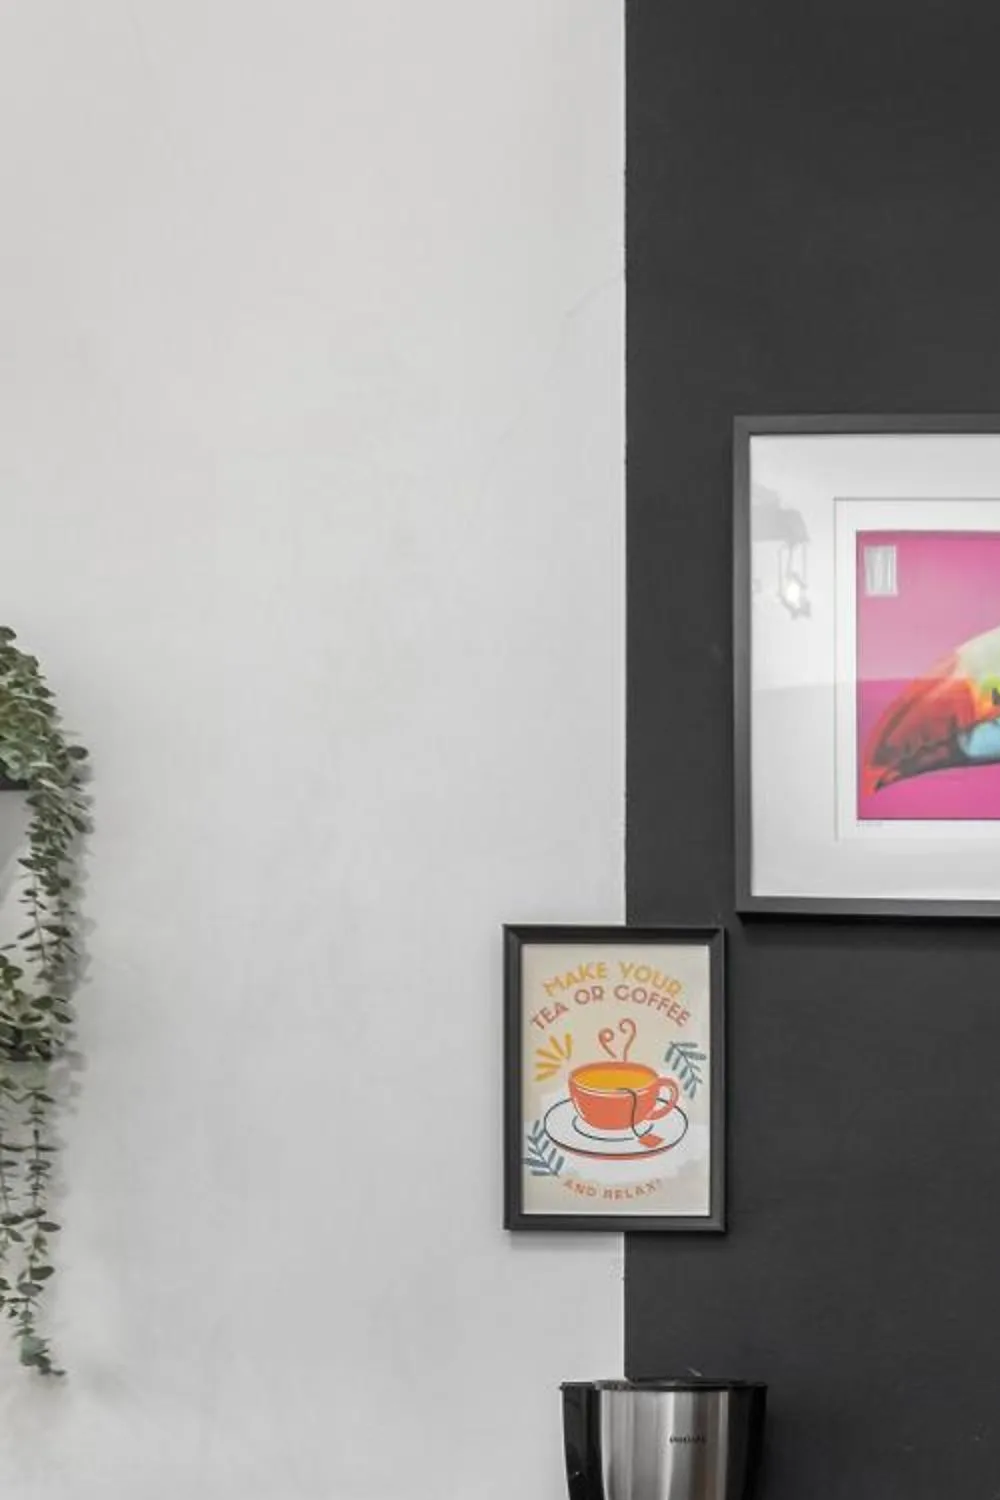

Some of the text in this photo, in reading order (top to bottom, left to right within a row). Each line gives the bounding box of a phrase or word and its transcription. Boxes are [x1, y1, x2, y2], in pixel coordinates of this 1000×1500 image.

[543, 961, 682, 997] MAKE YOUR
[532, 984, 691, 1030] TEA OR COFFEE
[564, 1180, 597, 1197] AND
